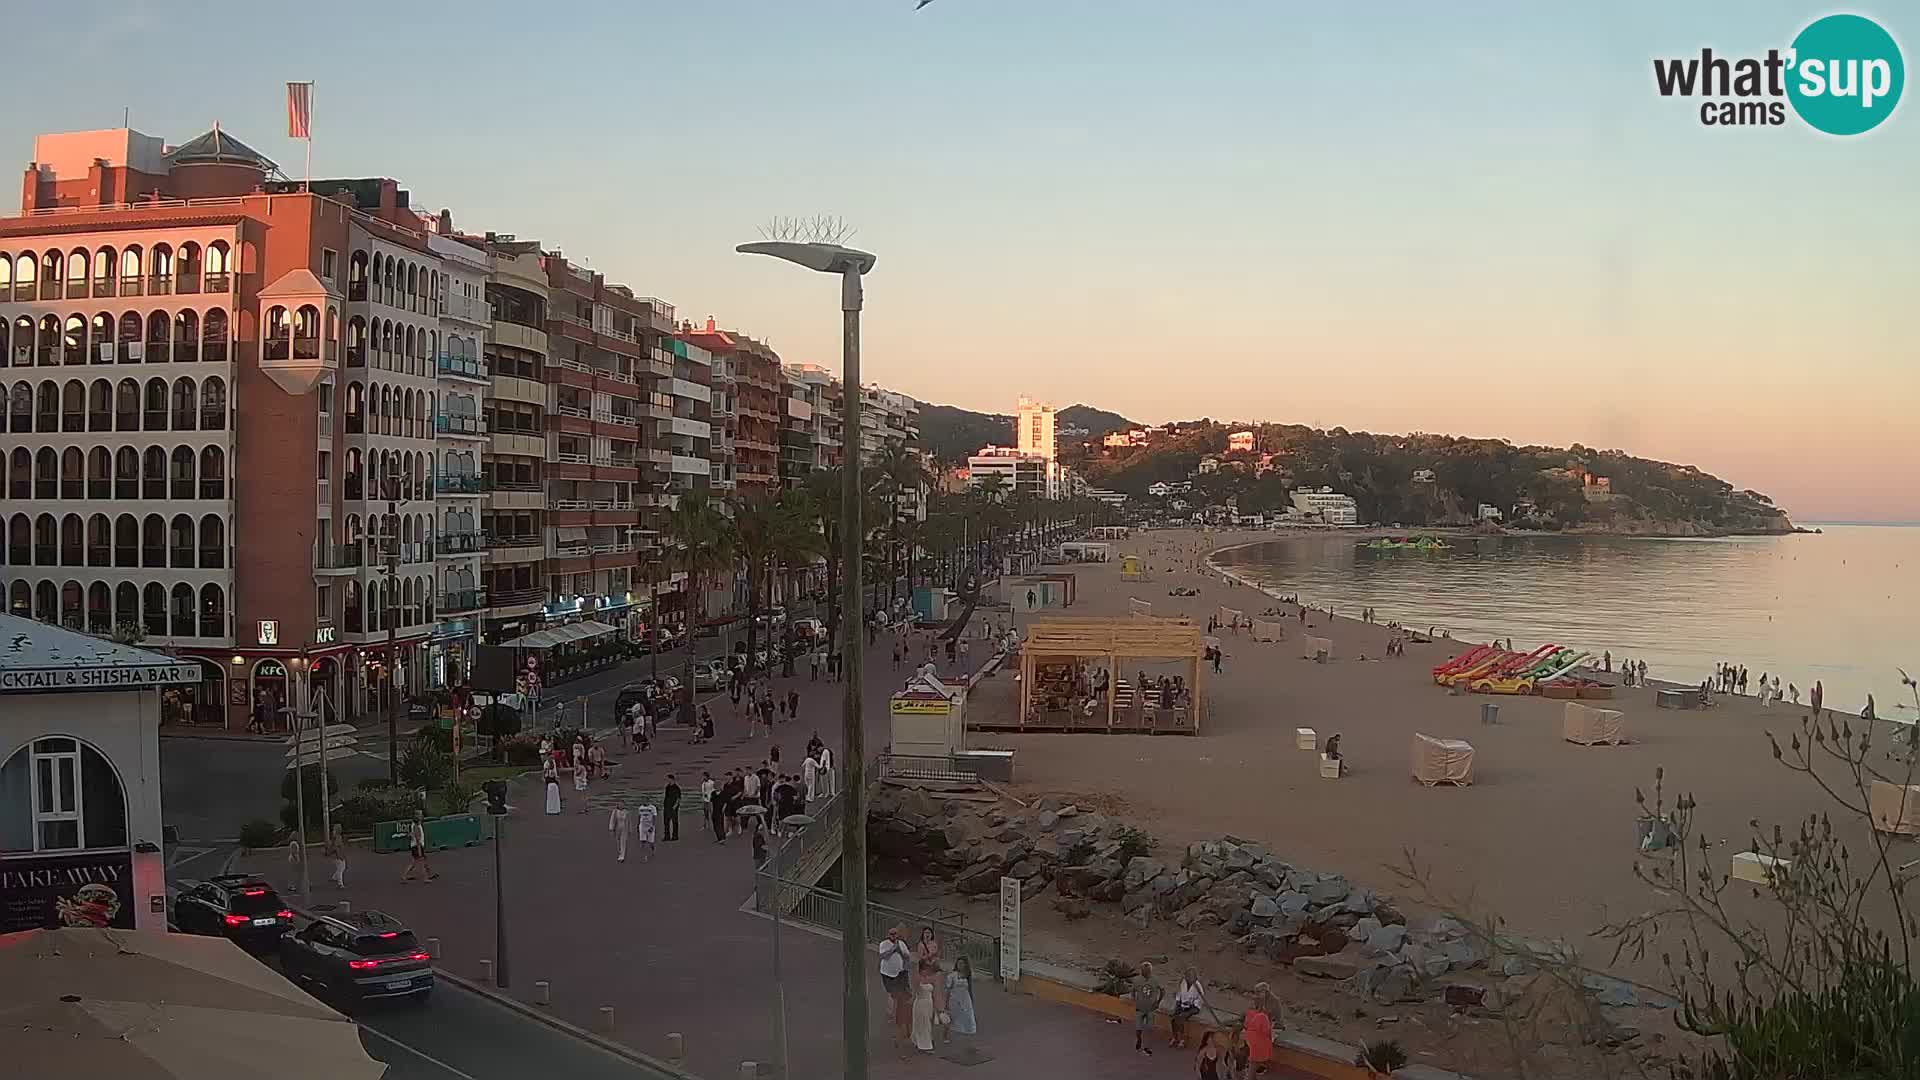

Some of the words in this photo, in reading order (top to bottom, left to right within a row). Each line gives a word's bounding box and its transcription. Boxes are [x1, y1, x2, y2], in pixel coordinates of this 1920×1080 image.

[316, 627, 335, 643] KFC
[1, 672, 61, 687] CKTAIL
[65, 671, 77, 685] &
[81, 669, 143, 685] SHISHA
[147, 667, 181, 682] BAR
[260, 666, 284, 676] KFC
